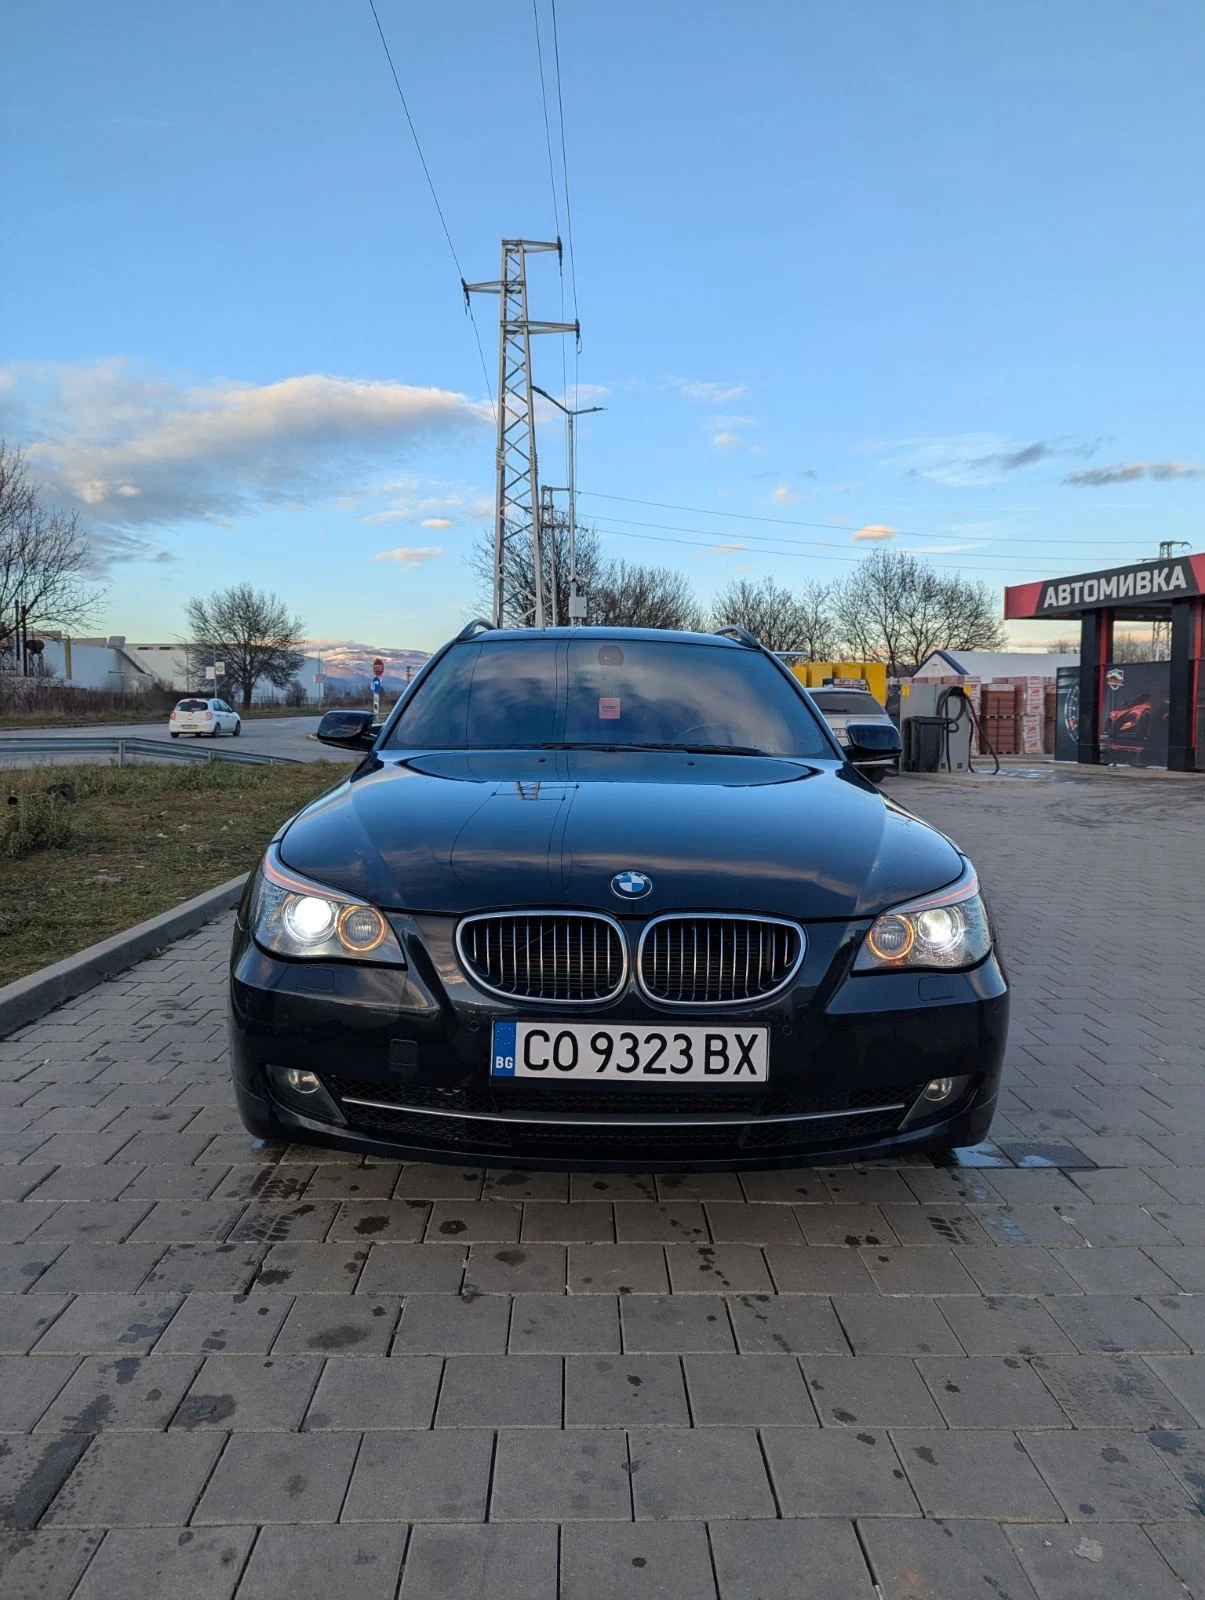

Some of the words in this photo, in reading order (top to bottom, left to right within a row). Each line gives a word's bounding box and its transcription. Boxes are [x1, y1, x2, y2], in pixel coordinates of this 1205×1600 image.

[1043, 565, 1187, 608] АВТОМИВКА
[495, 1056, 514, 1069] BG
[523, 1029, 579, 1072] CO
[590, 1031, 694, 1075] 9323
[704, 1033, 758, 1076] BX
